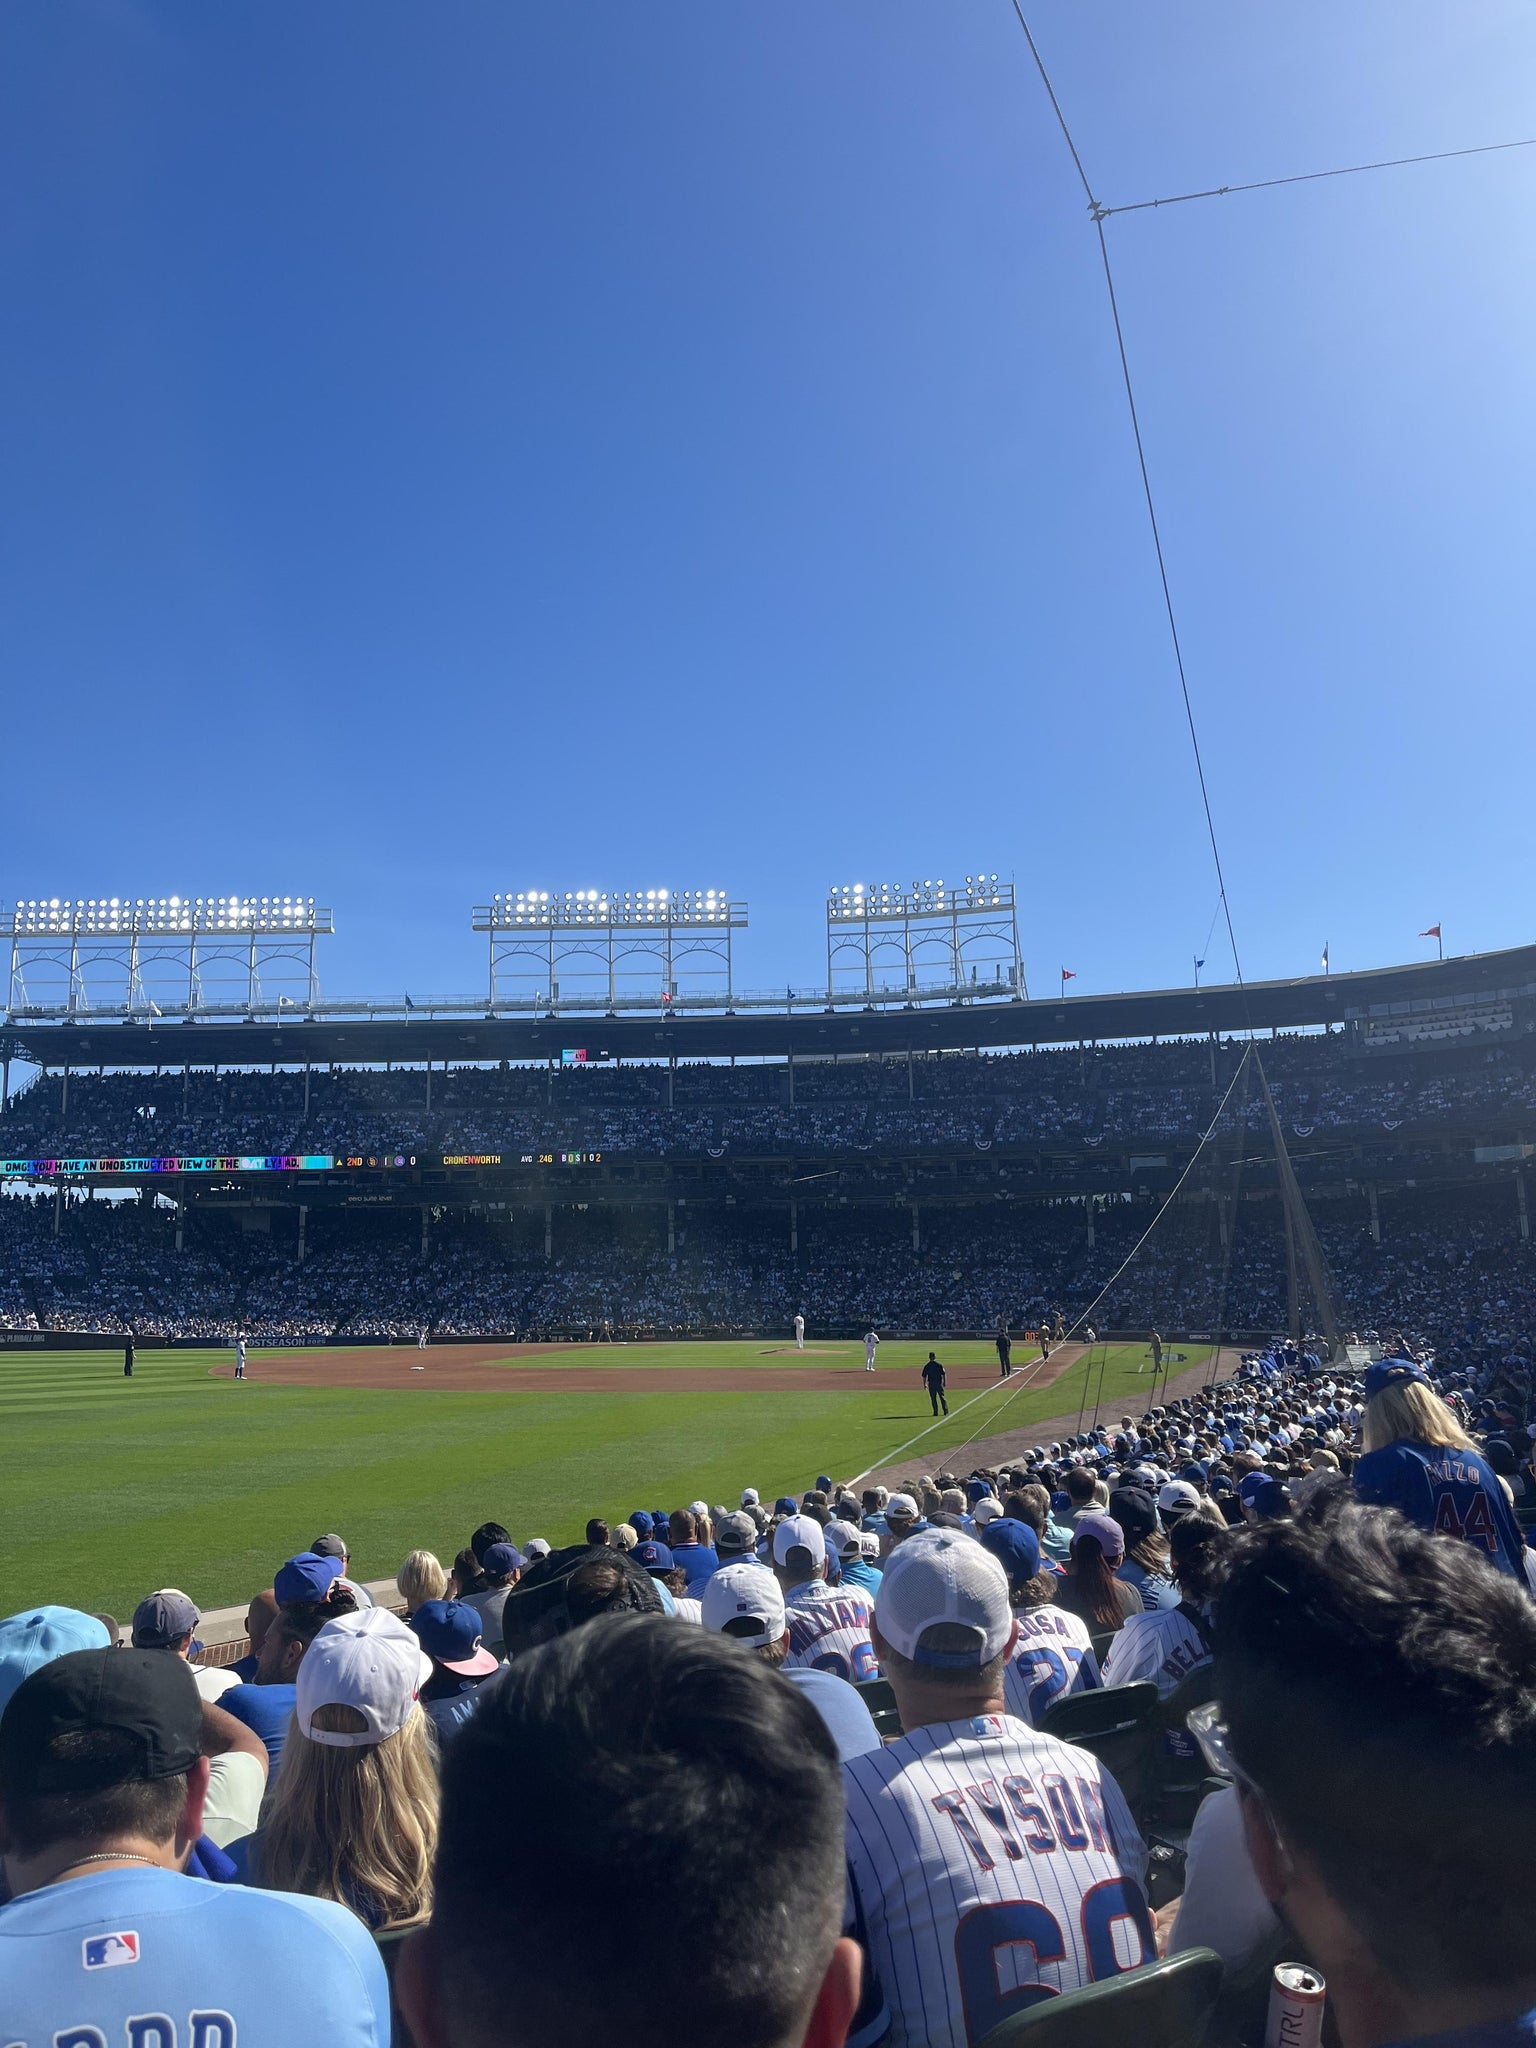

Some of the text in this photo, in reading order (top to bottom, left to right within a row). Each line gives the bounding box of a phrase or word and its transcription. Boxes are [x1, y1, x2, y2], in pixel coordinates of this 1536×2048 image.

[5, 1162, 30, 1172] OMG!
[33, 1162, 51, 1171] YOU
[55, 1161, 80, 1171] HAVE
[83, 1161, 97, 1171] AN
[100, 1160, 175, 1171] UNOBSTRUCTED
[177, 1159, 203, 1169] VIEW
[206, 1159, 217, 1169] OF
[220, 1159, 239, 1169] THE
[285, 1158, 299, 1168] AD.
[347, 1157, 363, 1167] 2ND
[410, 1156, 416, 1166] 0
[443, 1155, 501, 1165] CRONENWORTH
[520, 1155, 533, 1163] AVG
[248, 1338, 305, 1347] OSTSEASON
[1434, 1491, 1498, 1552] 44
[931, 1773, 1119, 1872] TYSON
